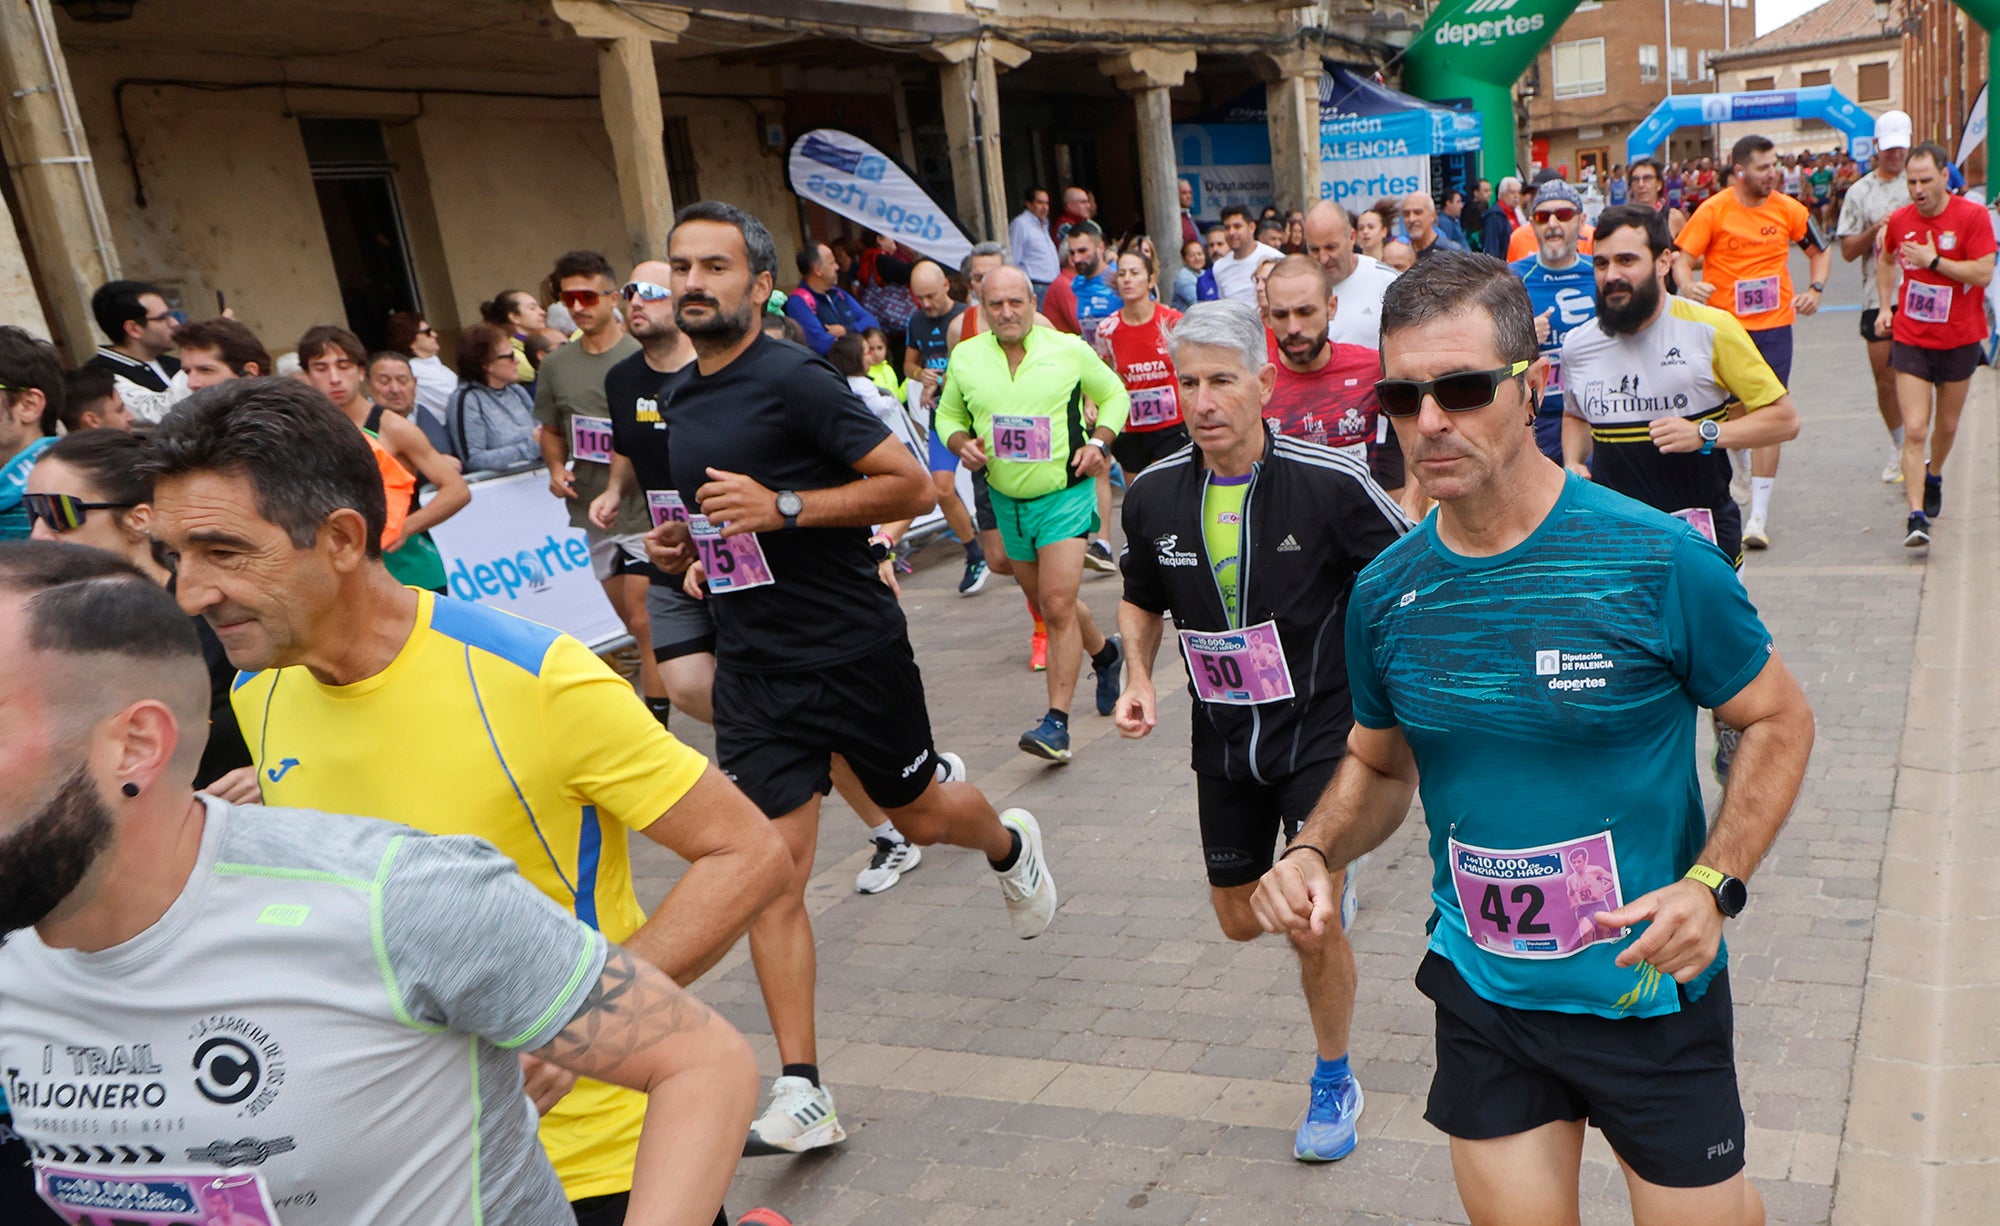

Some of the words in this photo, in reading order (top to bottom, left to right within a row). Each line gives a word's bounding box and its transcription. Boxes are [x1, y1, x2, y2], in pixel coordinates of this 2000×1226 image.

[1435, 13, 1545, 46] deportes
[1320, 119, 1383, 135] tación
[1320, 138, 1409, 159] ALENCIA
[1320, 173, 1419, 203] eportes
[1744, 289, 1764, 306] 53
[1908, 293, 1935, 313] 184
[1127, 360, 1167, 374] TROTA
[1134, 399, 1162, 418] 121
[576, 429, 613, 453] 110
[1001, 429, 1027, 451] 45
[699, 537, 736, 575] 75
[1158, 555, 1198, 568] Requena
[450, 533, 591, 602] deporte
[1562, 653, 1603, 662] Diputación
[1562, 662, 1573, 671] DE
[1574, 660, 1614, 671] PALENCIA
[1201, 654, 1244, 689] 50
[1548, 677, 1607, 691] deportes
[1463, 862, 1514, 878] MARIANO
[1516, 865, 1554, 878] HARO
[1477, 856, 1529, 870] 10.000
[1480, 883, 1552, 935] 42
[42, 1043, 53, 1075] I
[66, 1042, 163, 1076] TRAIL
[7, 1067, 167, 1109] TRIJONERO
[1706, 1137, 1735, 1160] FILA
